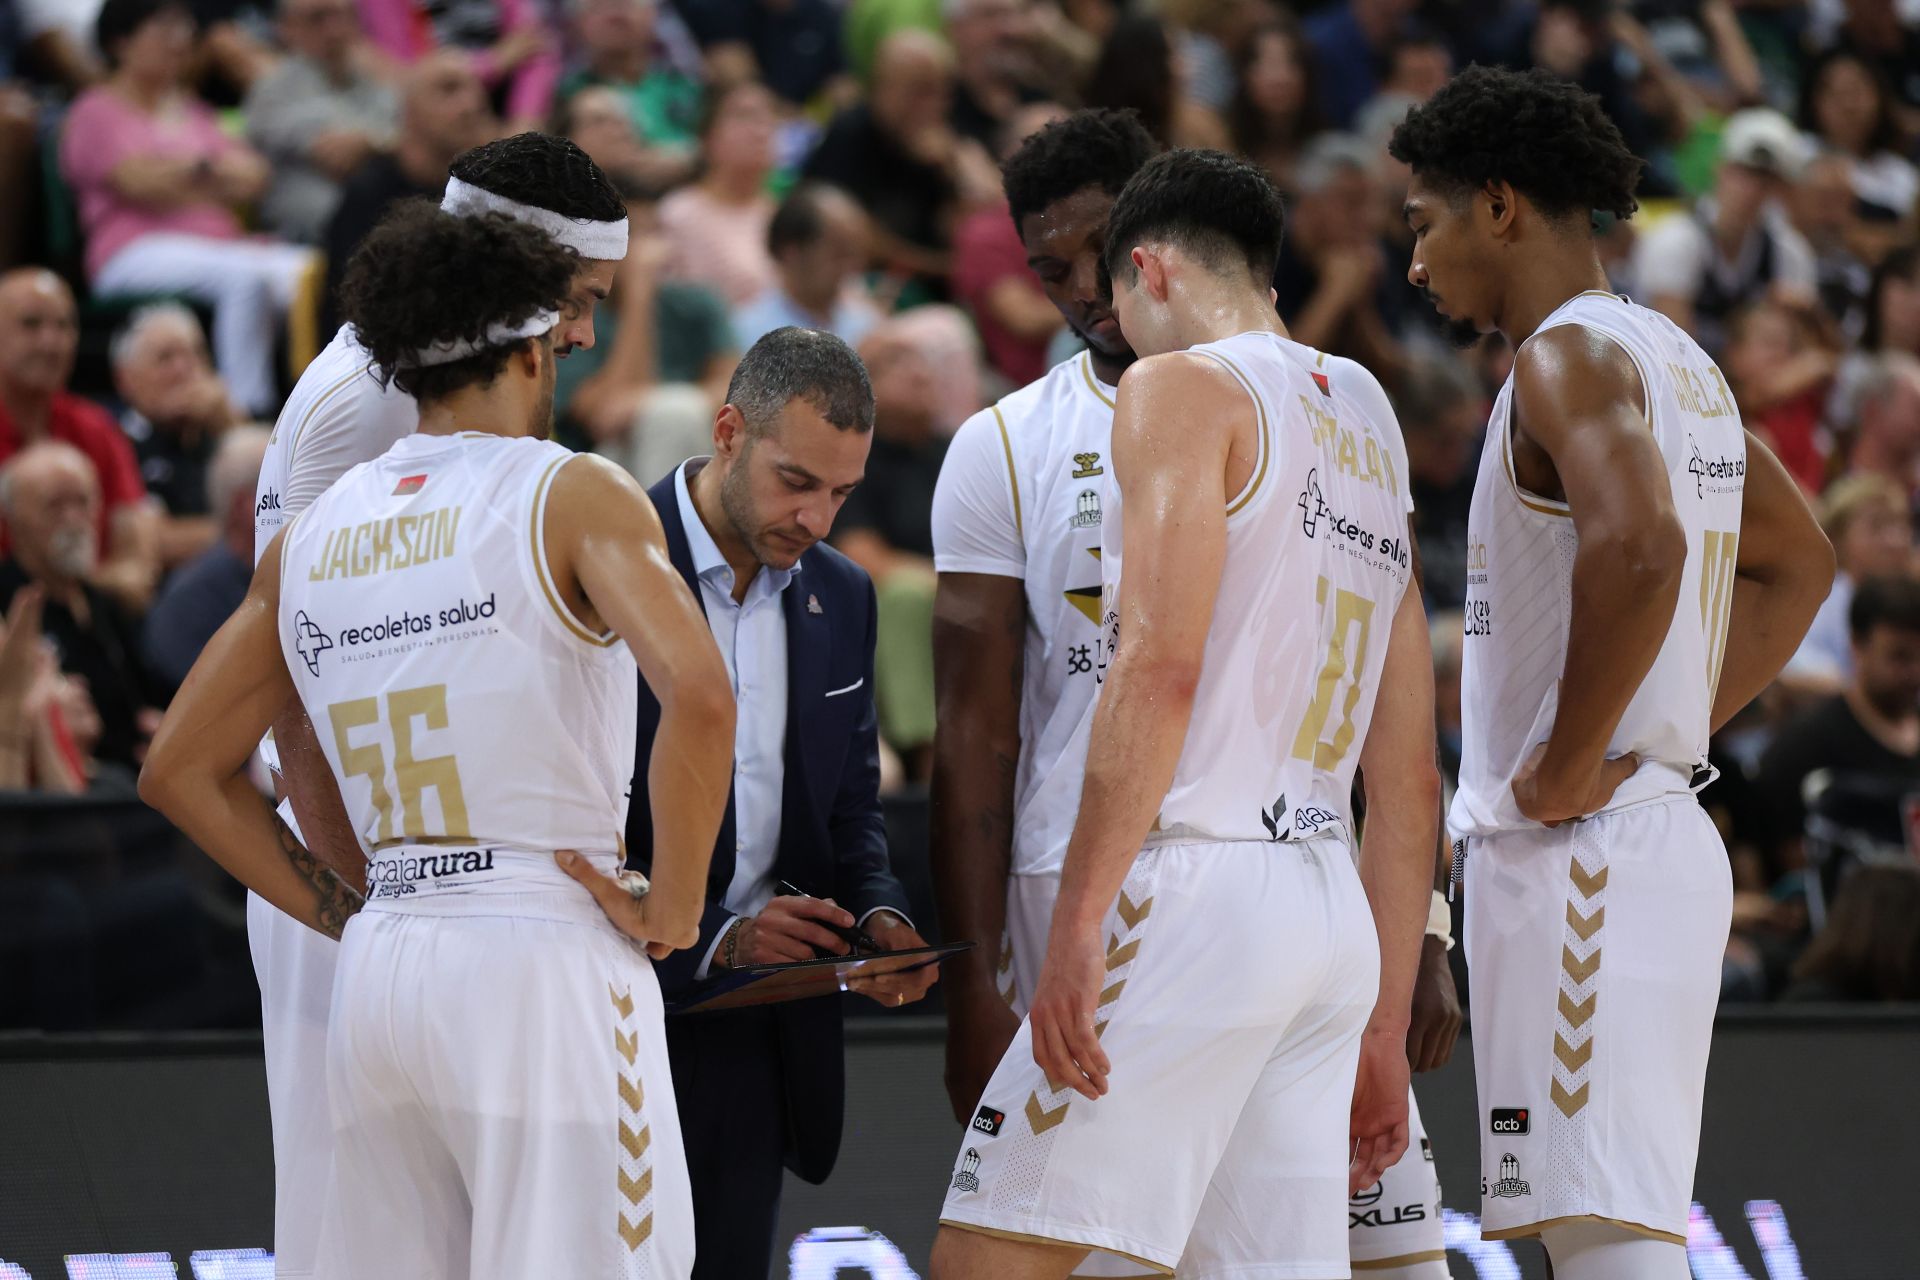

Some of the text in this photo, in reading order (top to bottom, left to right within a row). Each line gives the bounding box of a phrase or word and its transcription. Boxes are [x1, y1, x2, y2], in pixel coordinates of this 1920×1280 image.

[308, 505, 462, 582] JACKSON
[340, 592, 495, 647] recoletas salud
[328, 684, 476, 843] 56
[975, 1115, 994, 1132] acb
[1493, 1117, 1520, 1131] acb
[1494, 1181, 1528, 1193] BURGOS
